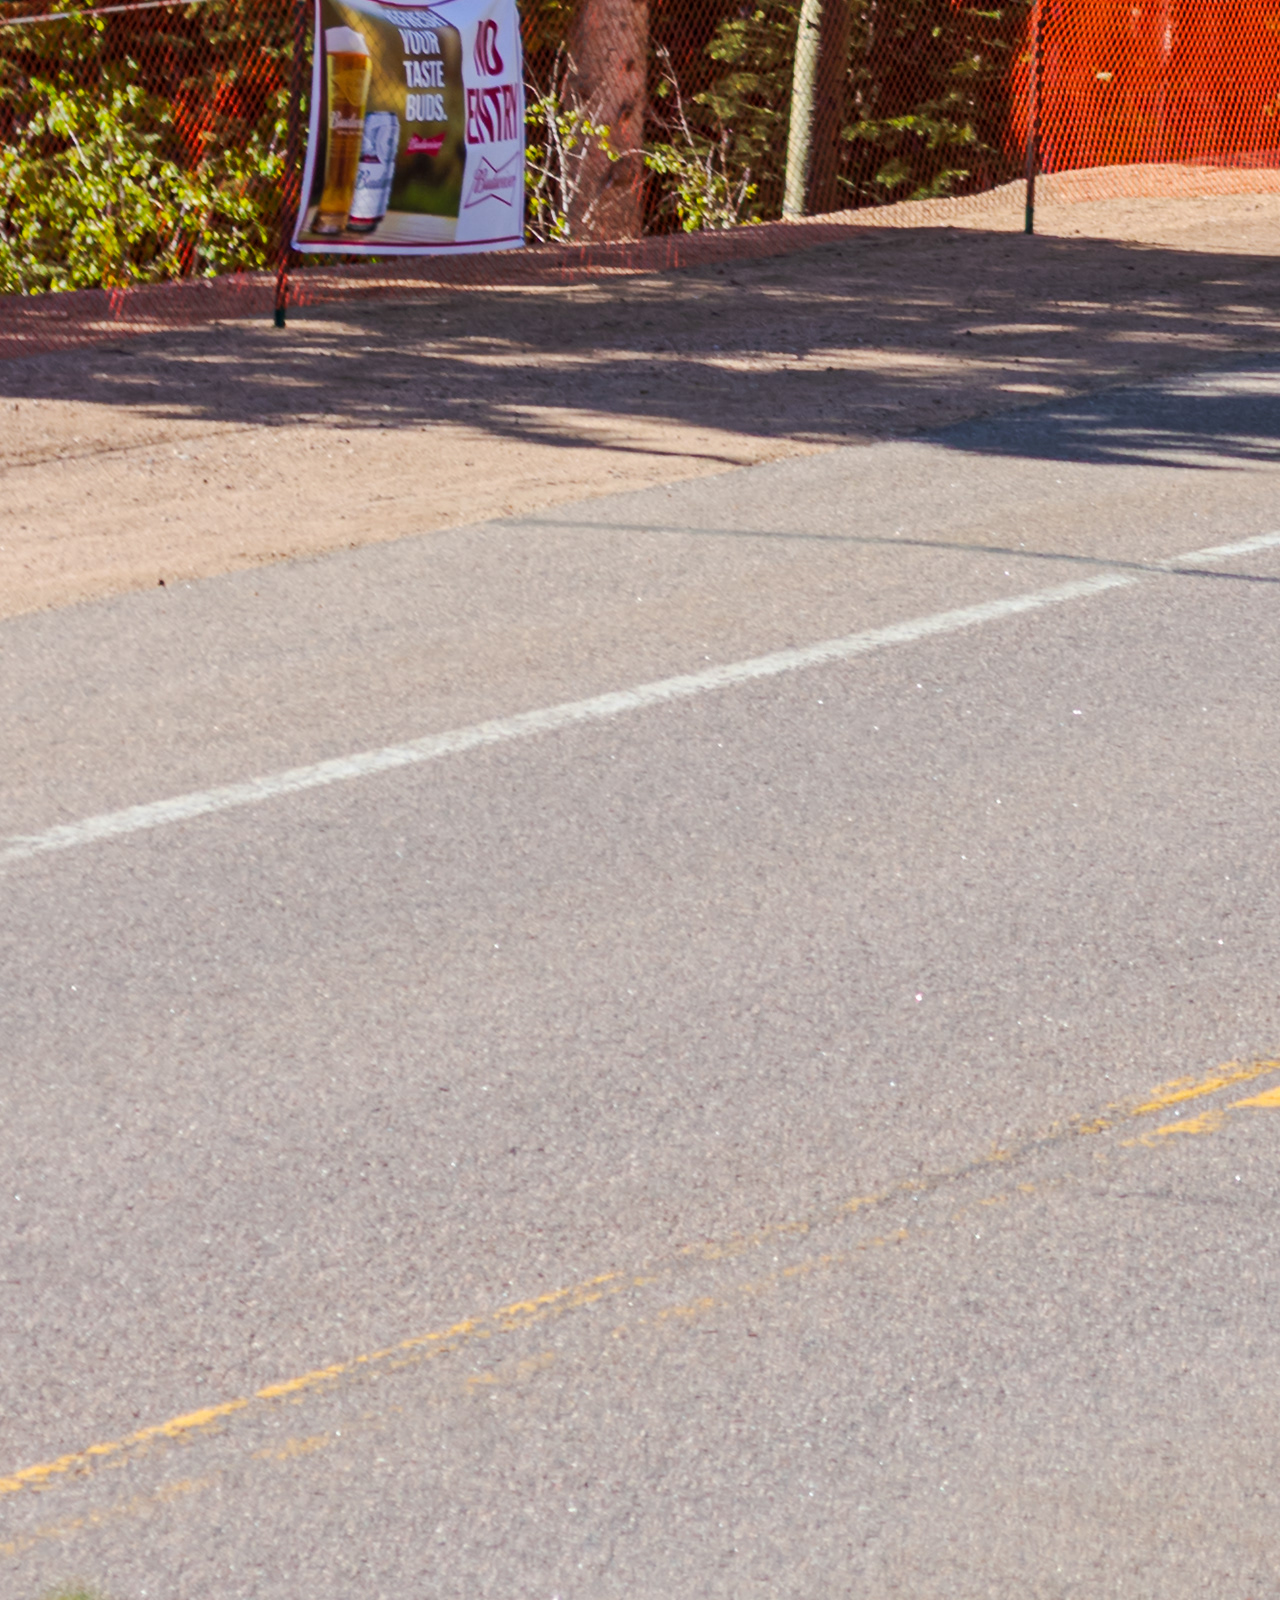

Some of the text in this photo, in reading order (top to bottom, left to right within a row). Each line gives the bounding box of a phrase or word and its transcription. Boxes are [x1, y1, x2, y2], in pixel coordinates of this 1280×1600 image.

[398, 28, 441, 55] YOUR
[473, 19, 504, 77] NO
[403, 61, 446, 88] TASTE
[405, 94, 449, 122] BUDS.
